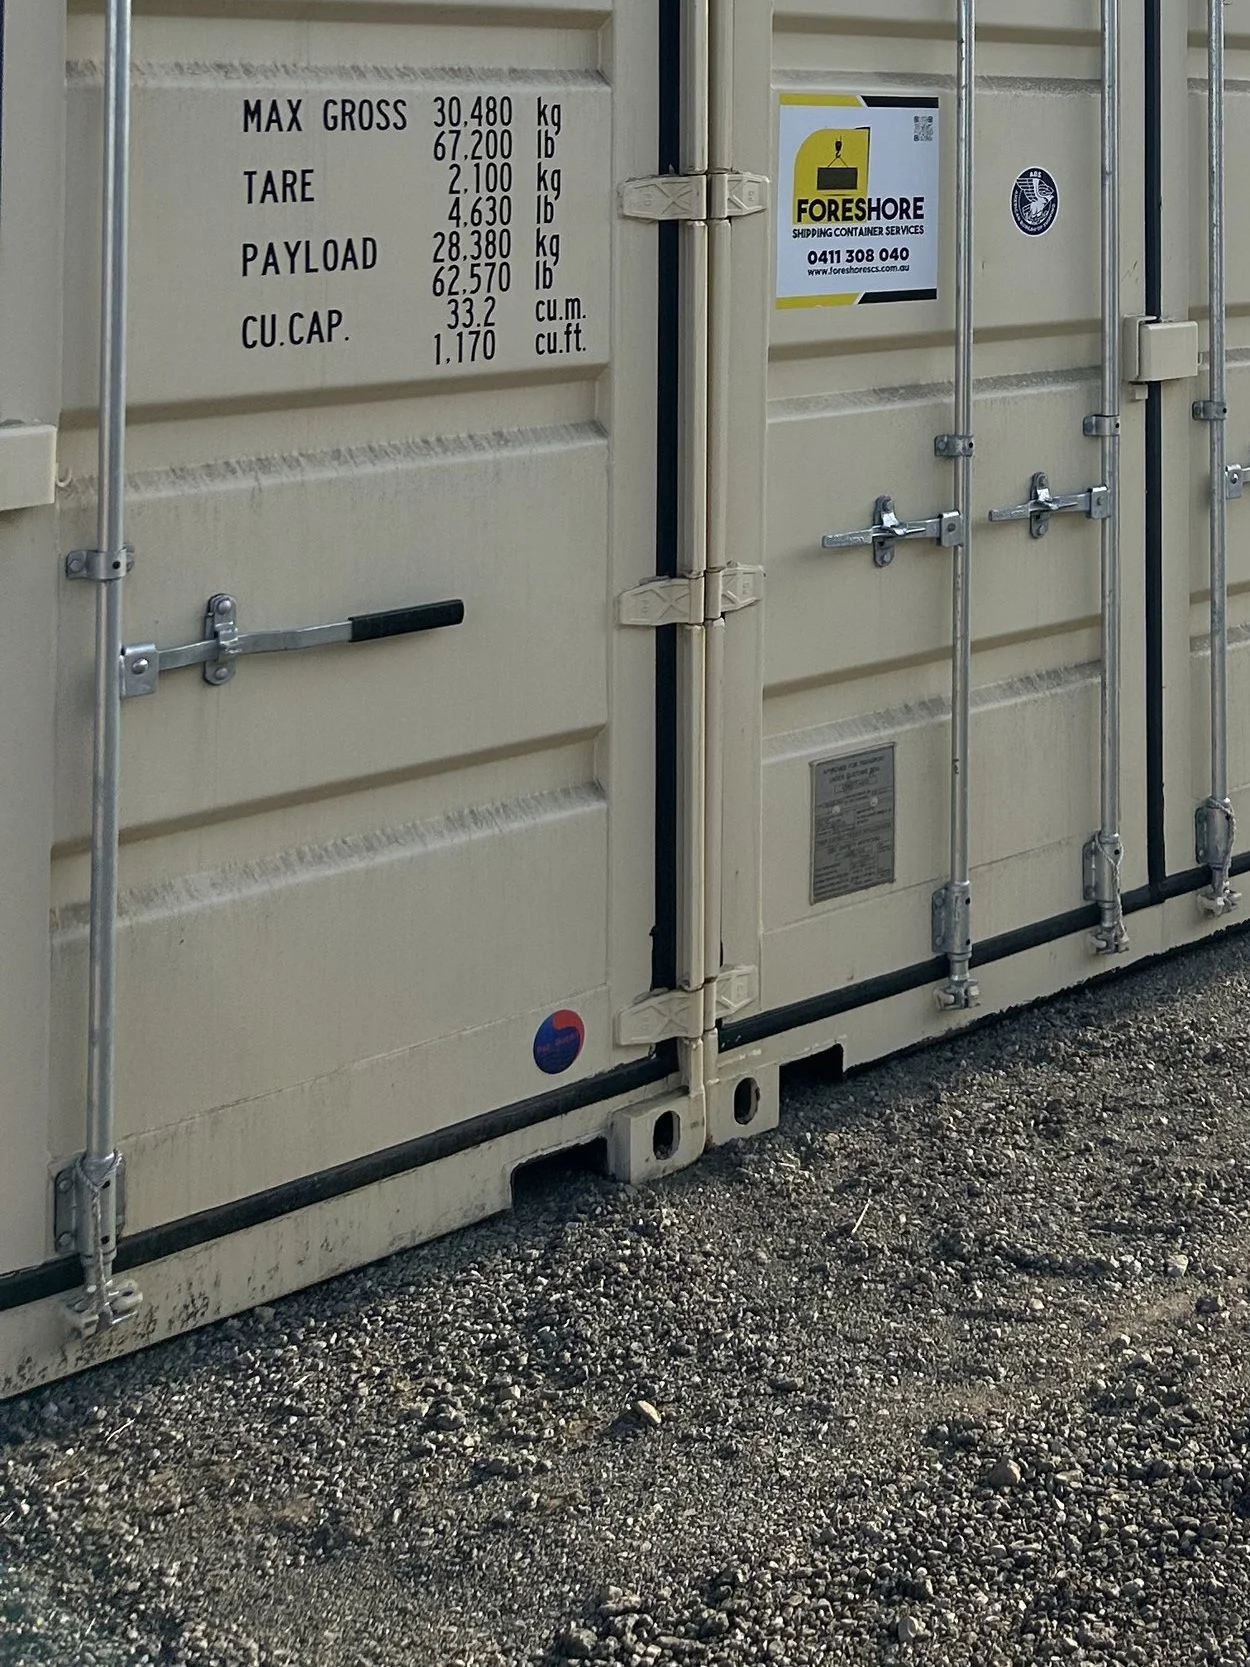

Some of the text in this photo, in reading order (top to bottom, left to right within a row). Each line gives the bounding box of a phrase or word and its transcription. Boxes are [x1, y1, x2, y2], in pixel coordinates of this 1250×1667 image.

[243, 96, 561, 136] MAX GROSS 30,480 kg
[433, 130, 554, 161] 67,200 lb
[243, 162, 561, 204] TARE 2,100 kg
[448, 194, 554, 227] 4,630 lb
[797, 197, 924, 222] FORESHORE
[793, 225, 924, 238] SHIPPING CONTAINER SERVICES
[242, 227, 559, 276] PAYLOAD 28,380 kg
[808, 247, 909, 264] 0411 308 040
[433, 260, 553, 296] 62,570 lb
[242, 296, 586, 349] CU.CAP. 33.2 cu.m.
[434, 323, 586, 365] 1,170 cu.ft.
